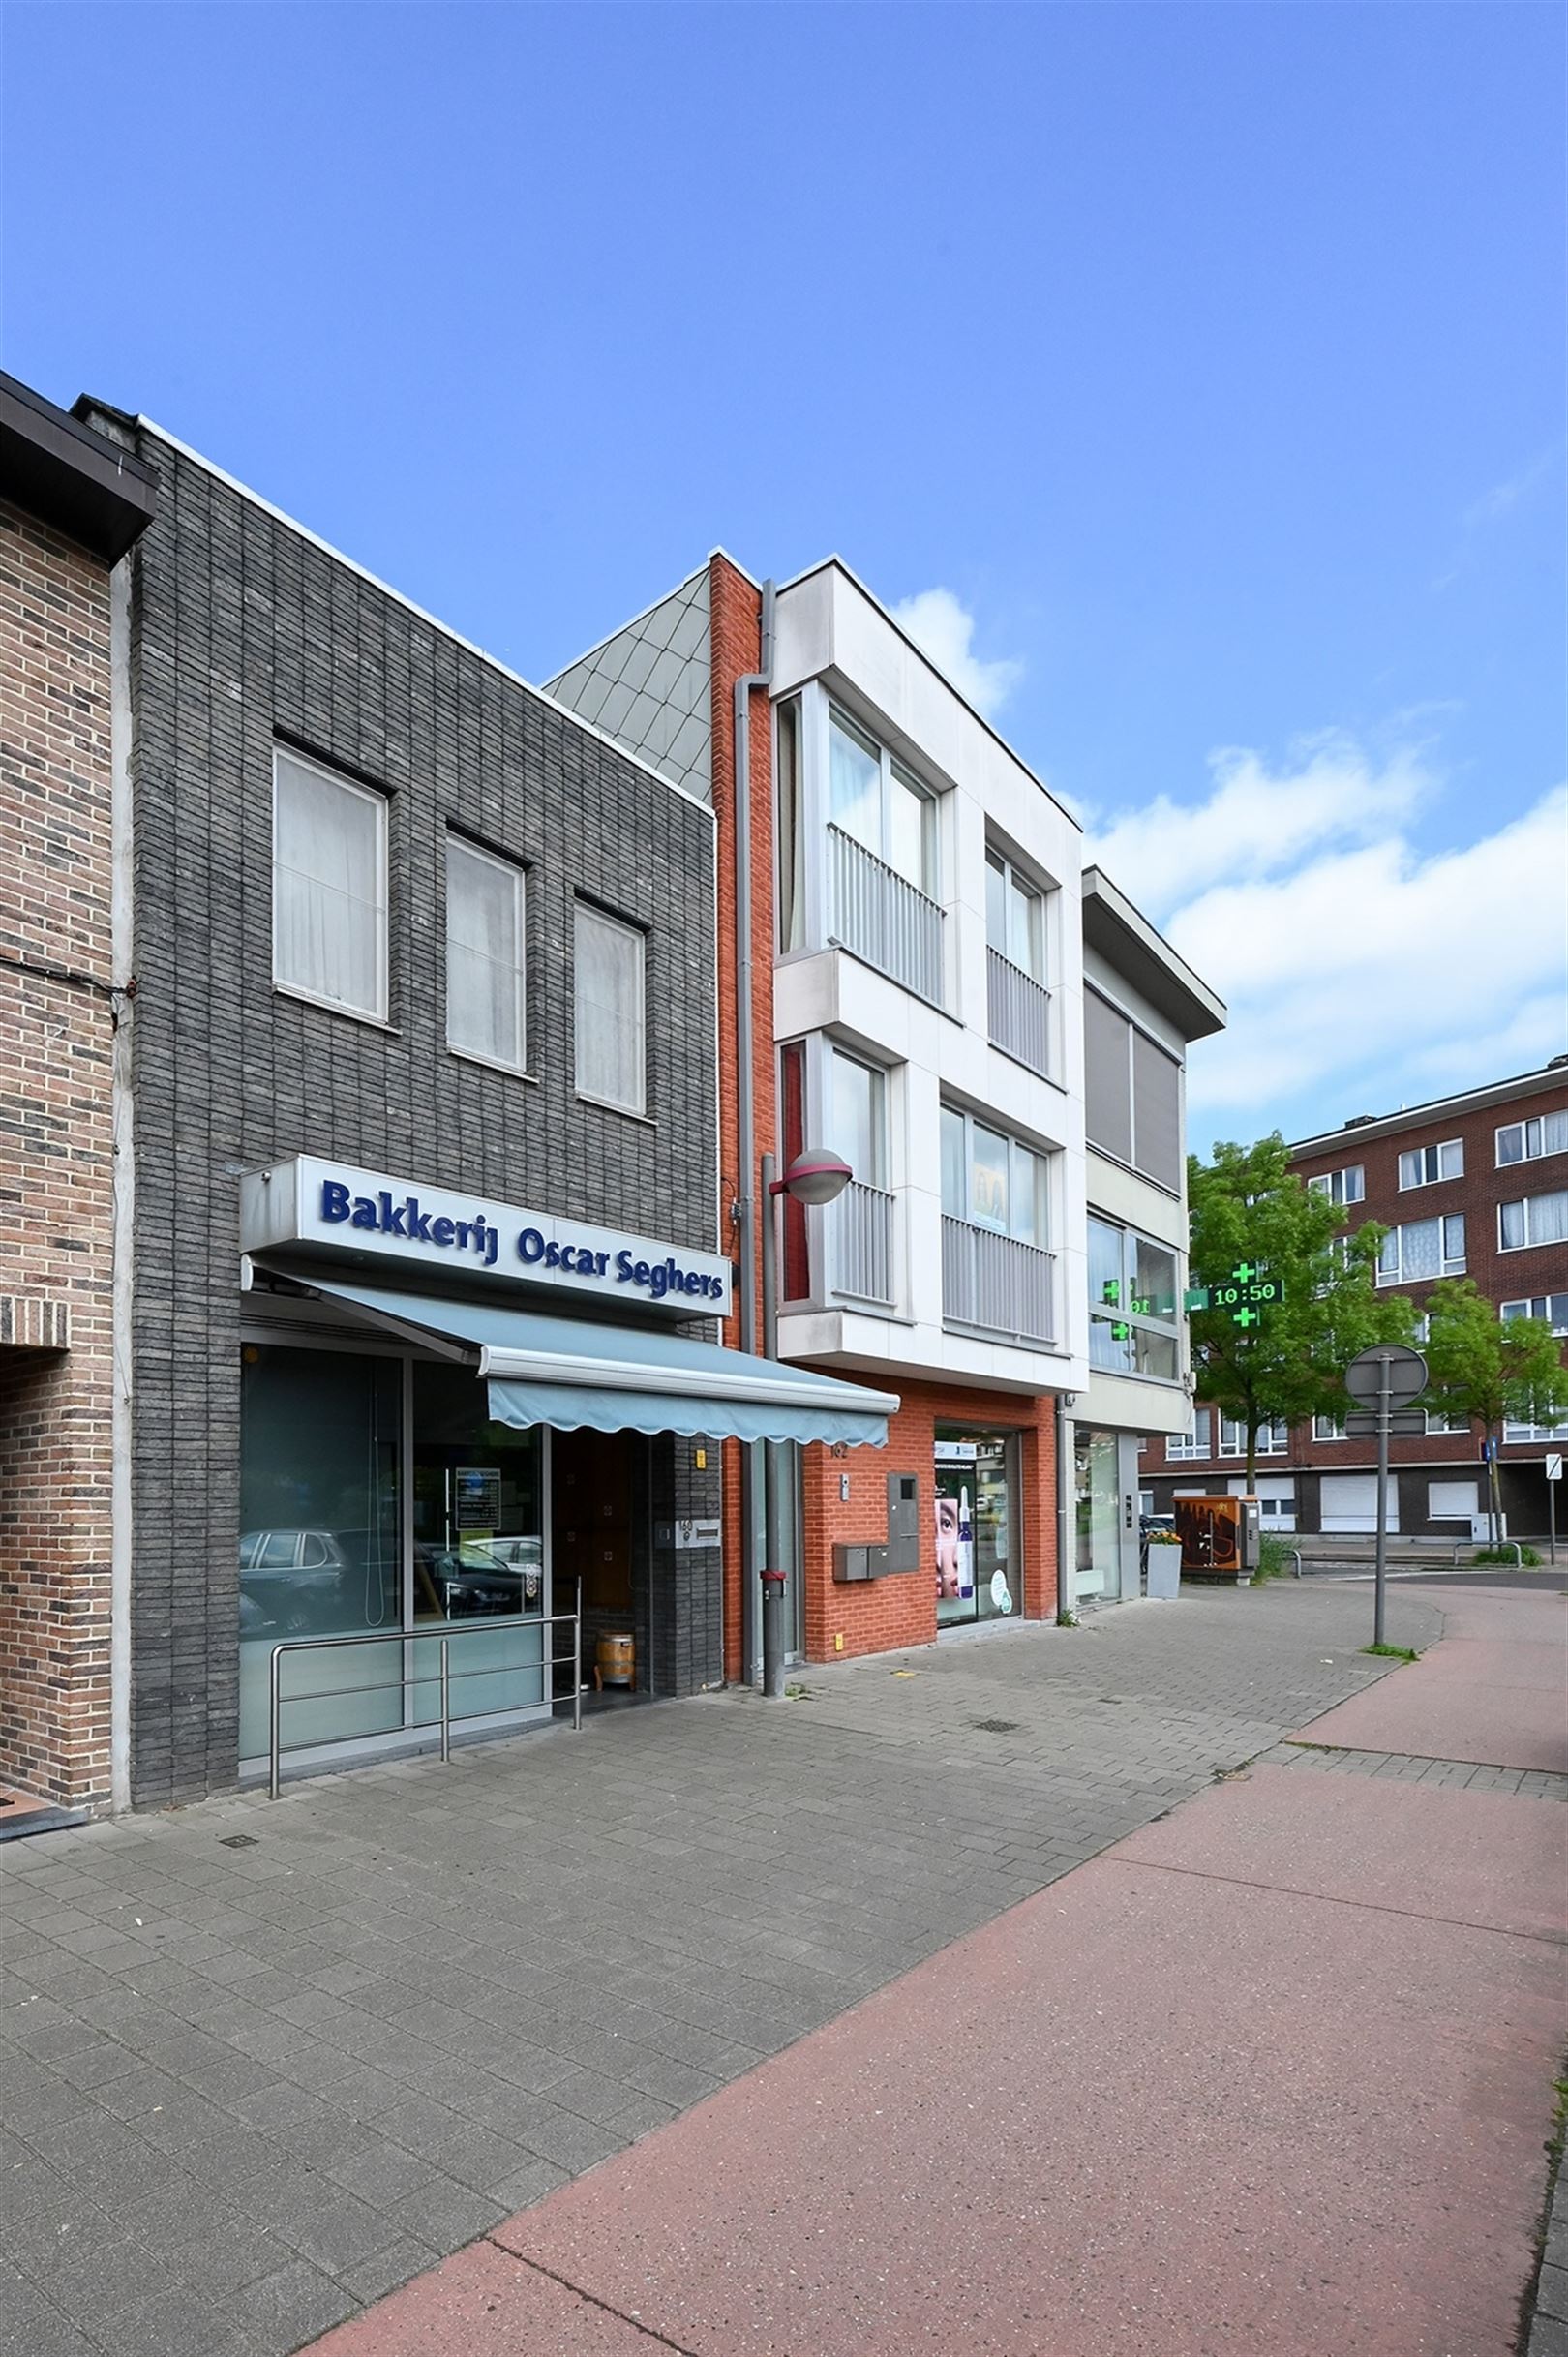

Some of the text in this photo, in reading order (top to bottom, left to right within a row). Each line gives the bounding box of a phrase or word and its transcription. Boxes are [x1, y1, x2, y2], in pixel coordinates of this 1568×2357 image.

[321, 1179, 723, 1299] Bakkerij Oscar Seghers
[1215, 1284, 1275, 1306] 10:50
[678, 1518, 693, 1531] 160
